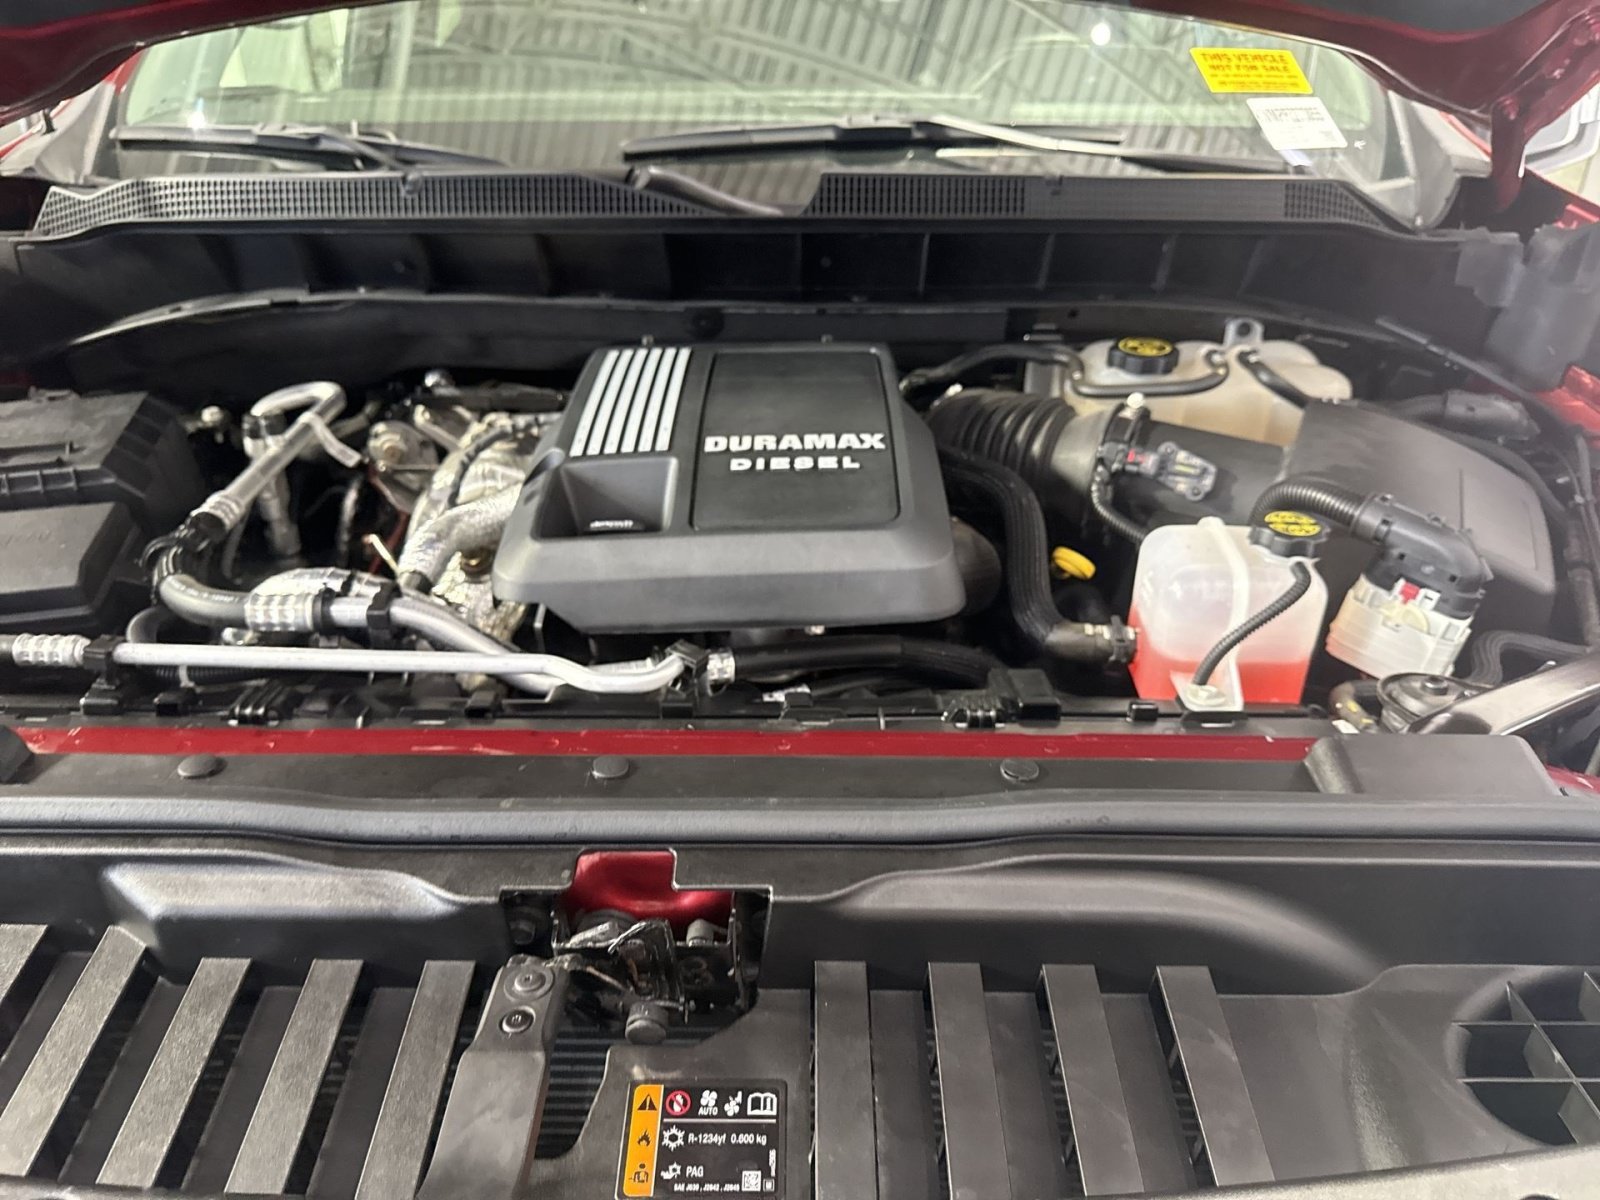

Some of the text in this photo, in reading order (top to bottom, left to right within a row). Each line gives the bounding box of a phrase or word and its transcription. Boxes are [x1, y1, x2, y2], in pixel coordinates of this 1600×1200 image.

[704, 433, 886, 453] DURAMAX
[730, 455, 860, 471] DIESEL
[698, 1106, 719, 1116] AUTO
[688, 1132, 727, 1146] R-1234yf
[756, 1132, 767, 1146] kg
[686, 1165, 704, 1178] PAG
